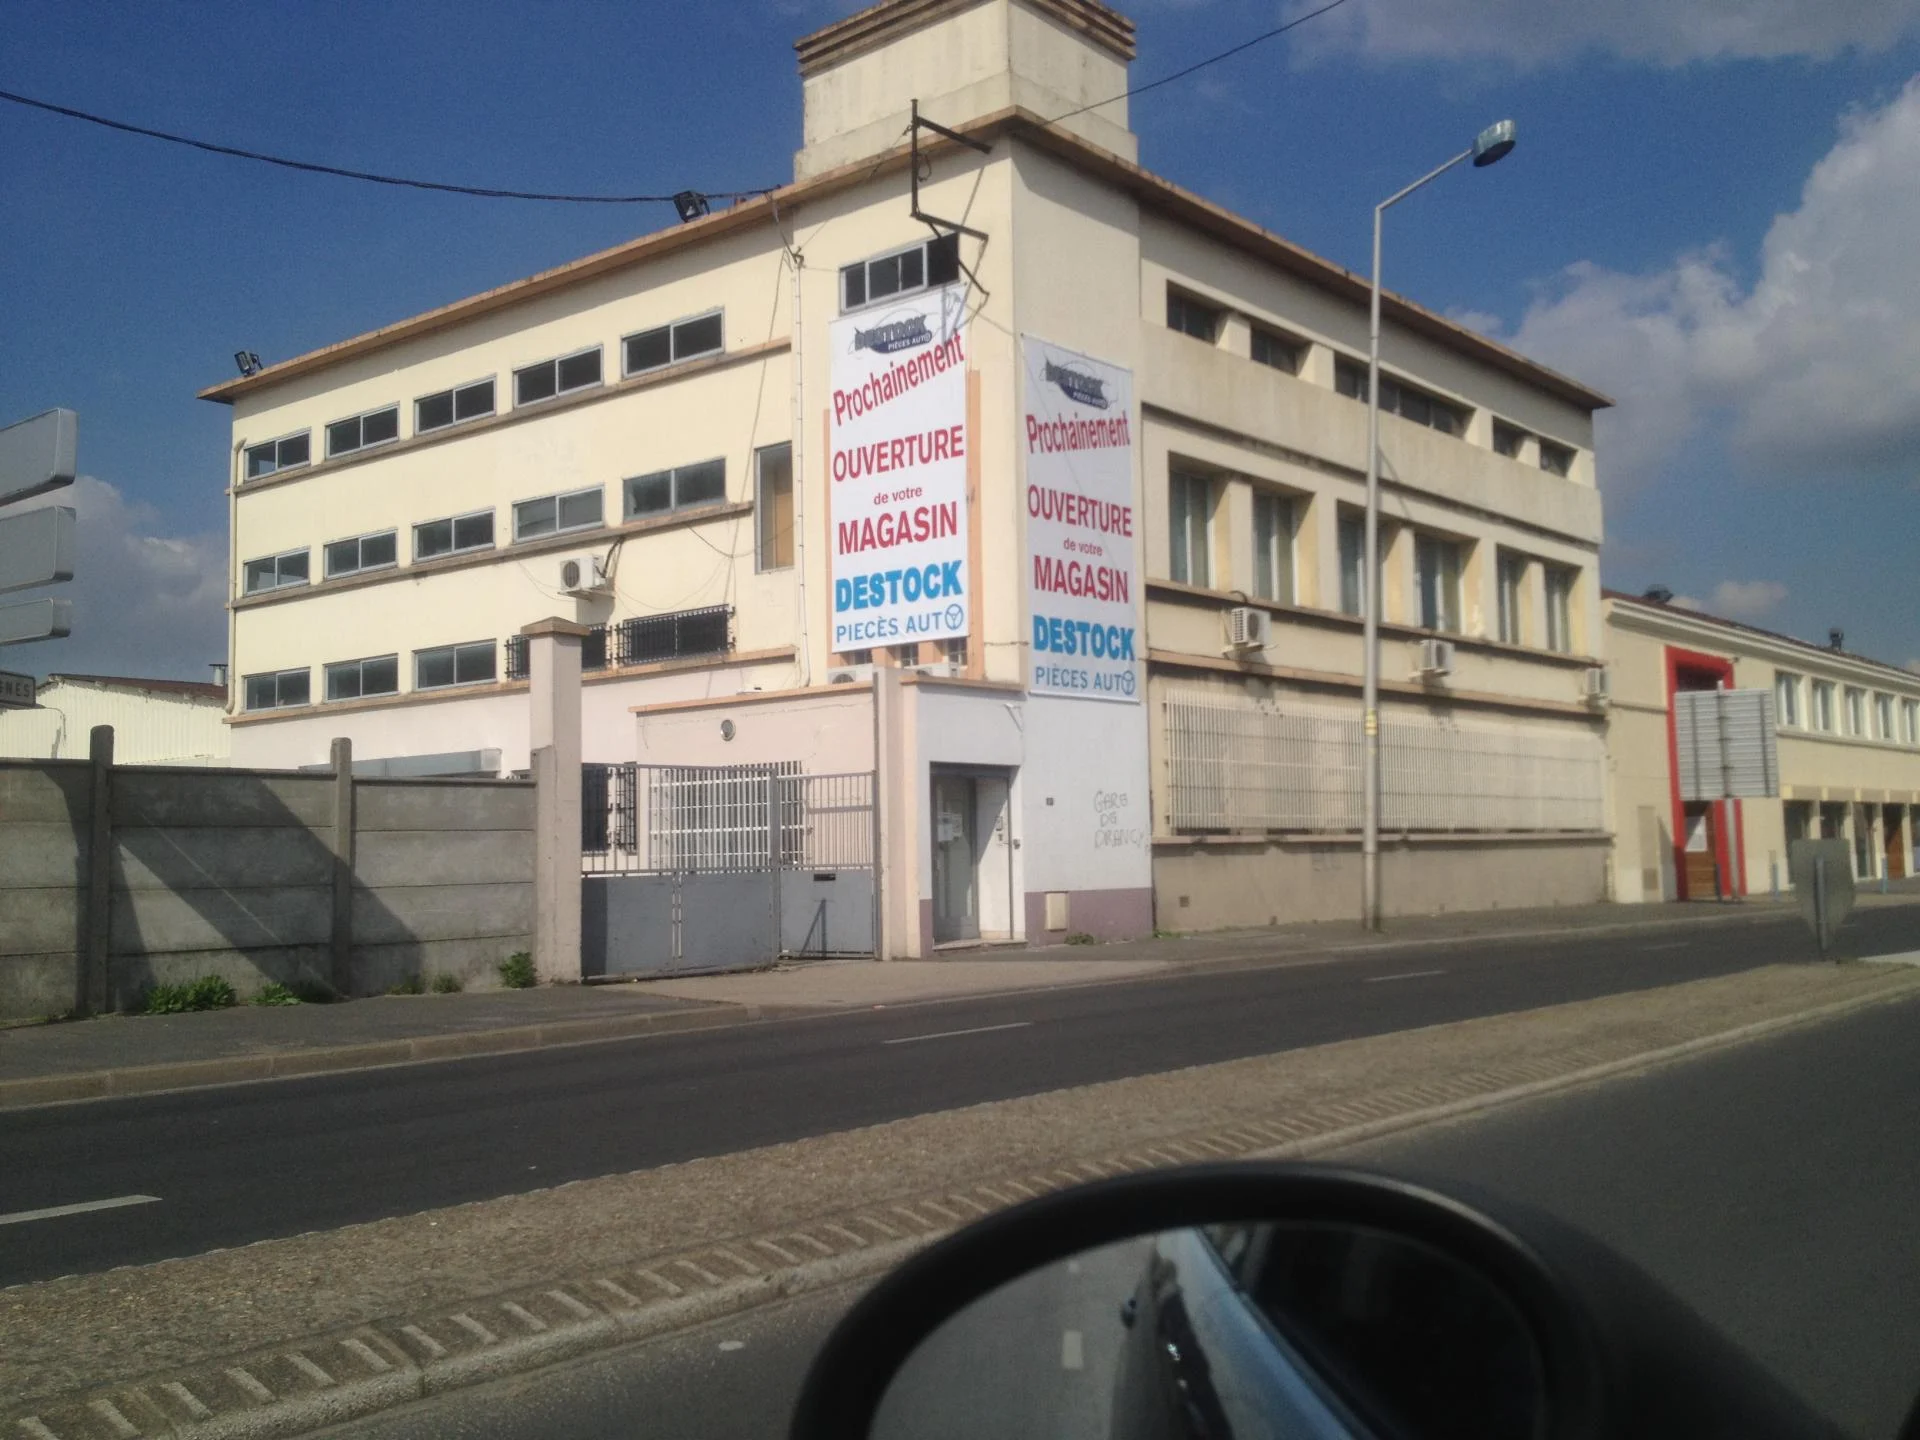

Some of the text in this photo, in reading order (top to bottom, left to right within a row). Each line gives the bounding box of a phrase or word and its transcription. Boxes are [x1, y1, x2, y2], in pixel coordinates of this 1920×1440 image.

[833, 327, 965, 427] Prochainement
[833, 424, 965, 482] OUVERTURE
[1026, 410, 1130, 454] Prochainement
[873, 486, 923, 505] de votre
[1028, 484, 1132, 537] OUVERTURE
[838, 501, 958, 555] MAGASIN
[1063, 538, 1103, 557] de votre
[835, 560, 964, 613] DESTOCK
[1034, 555, 1129, 604] MAGASIN
[1033, 614, 1136, 661] DESTOCK
[1035, 664, 1088, 689] PIÈCES
